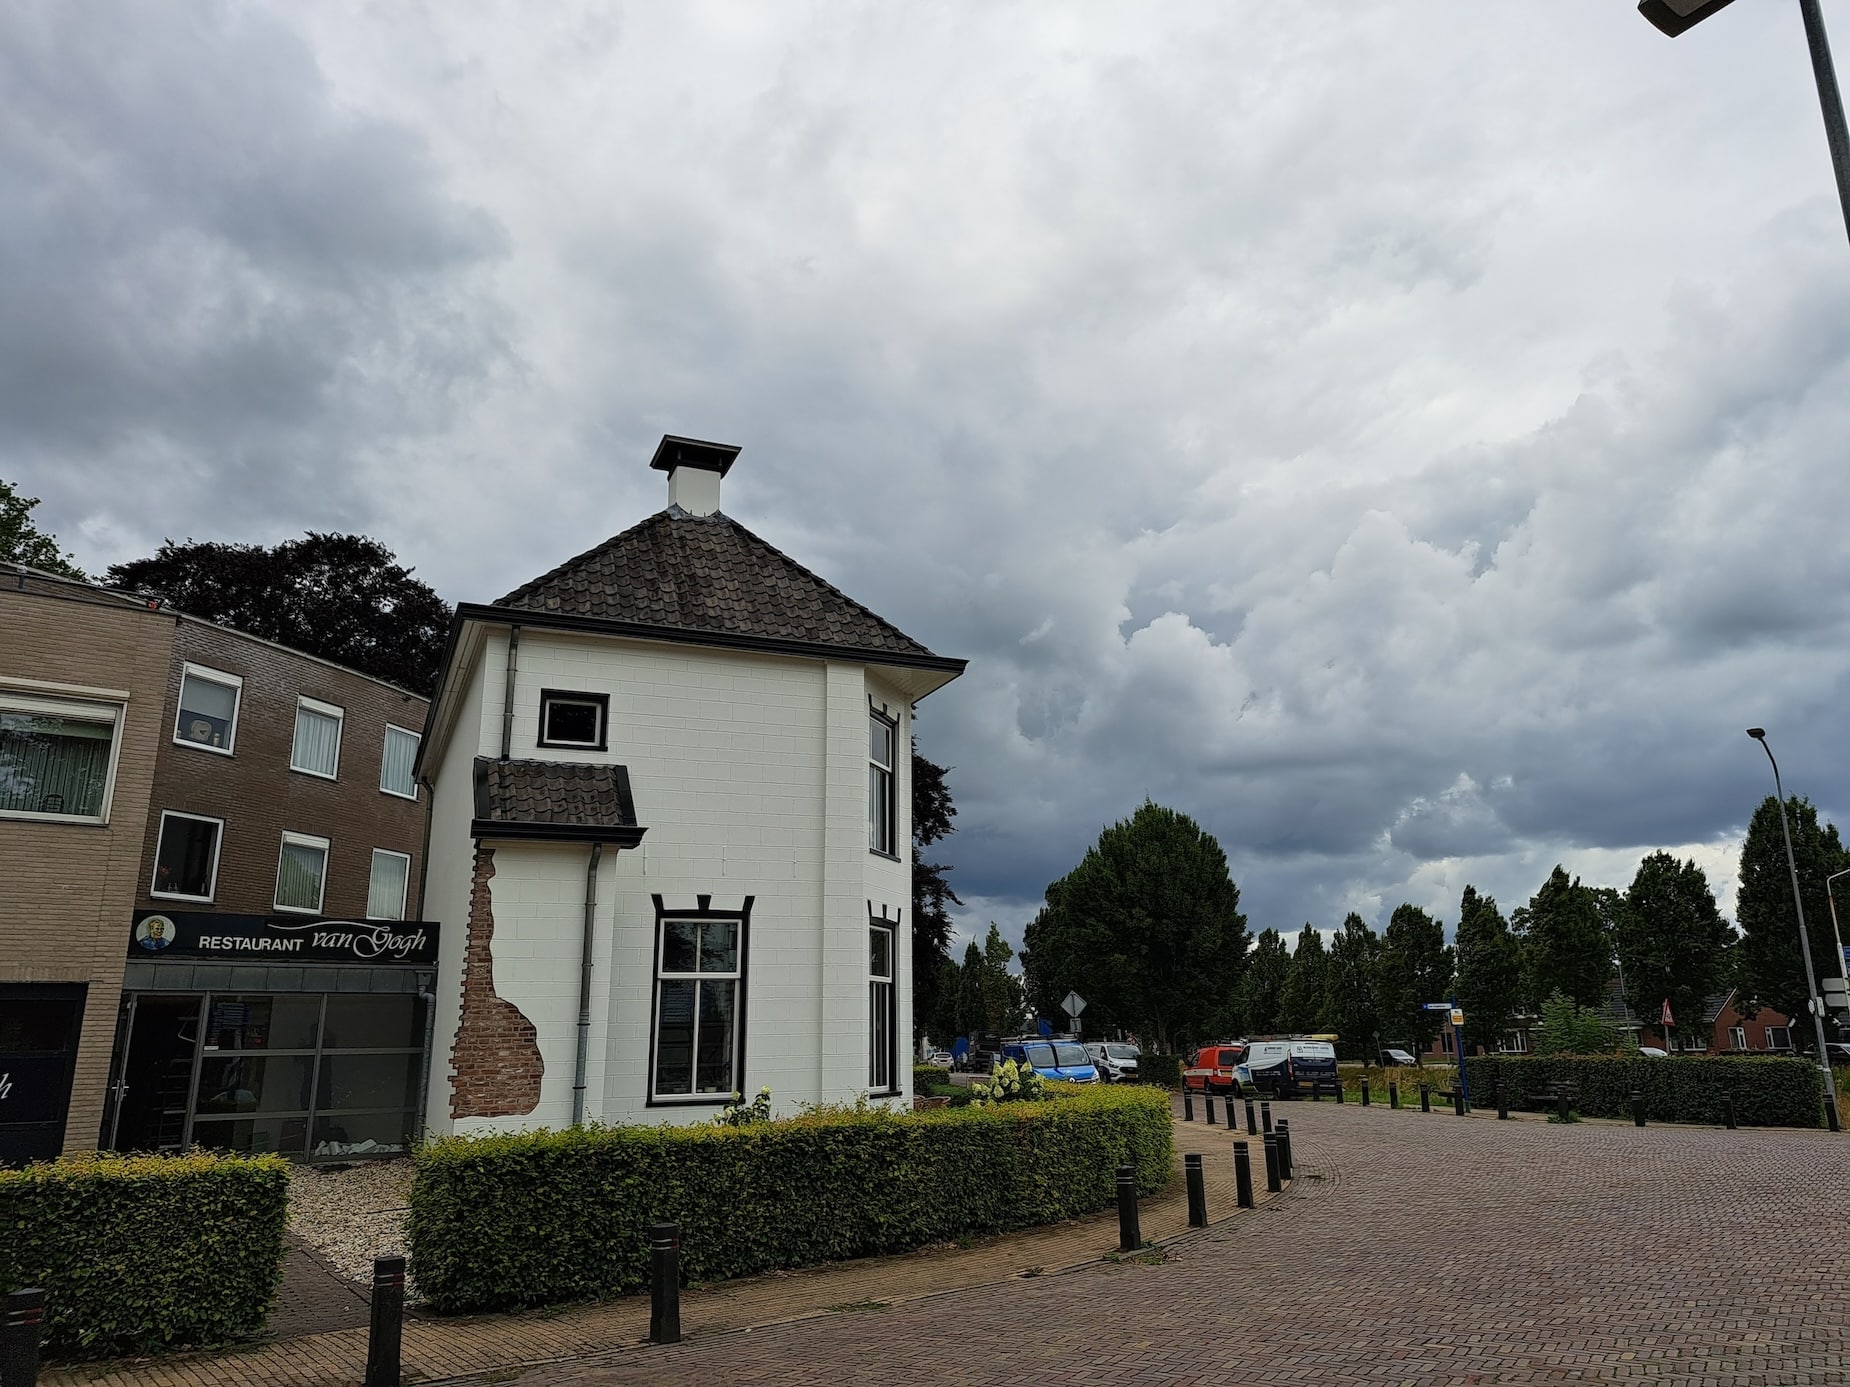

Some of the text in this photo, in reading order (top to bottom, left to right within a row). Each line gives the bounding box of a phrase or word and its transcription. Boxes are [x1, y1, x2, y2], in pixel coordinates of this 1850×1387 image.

[199, 926, 427, 958] RESTAURANT van Gogh
